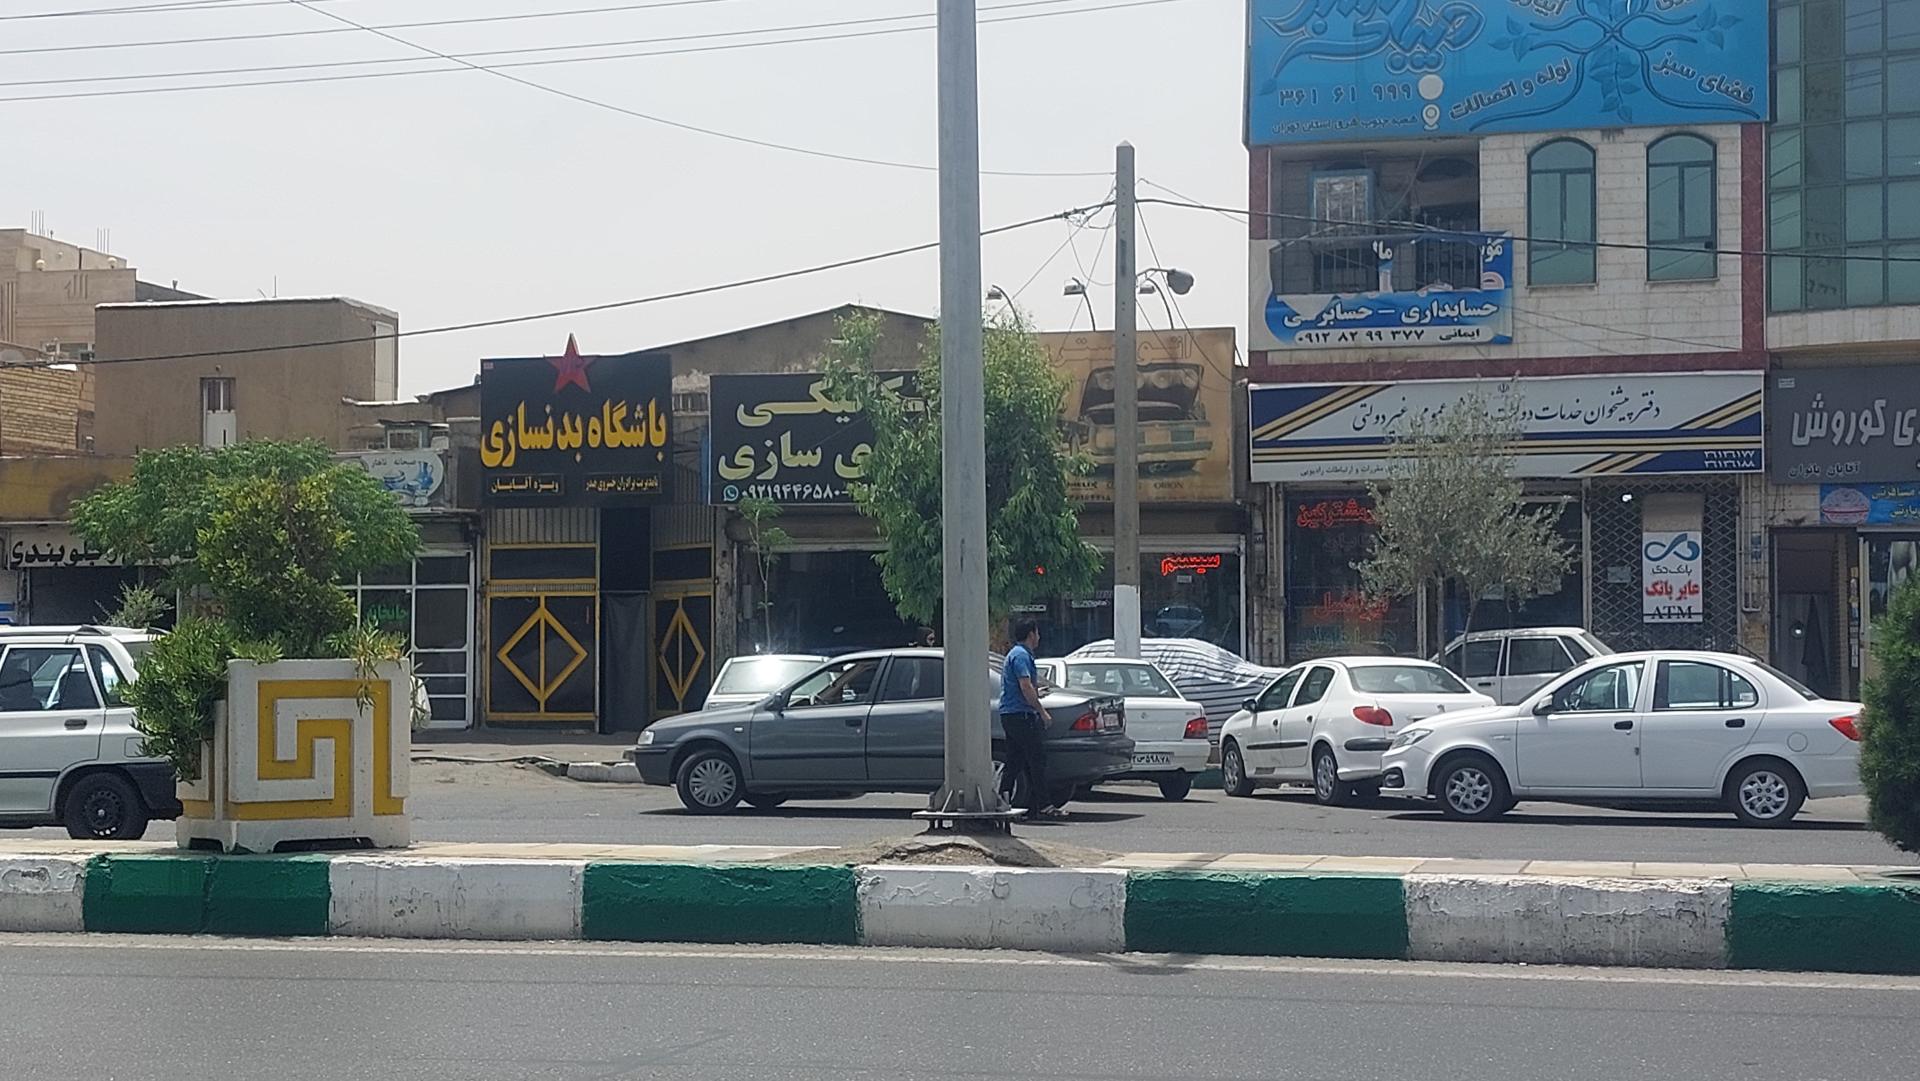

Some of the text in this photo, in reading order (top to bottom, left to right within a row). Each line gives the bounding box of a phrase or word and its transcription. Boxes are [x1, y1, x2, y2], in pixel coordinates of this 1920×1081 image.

[1449, 57, 1572, 120] لوله و اتصالات
[1651, 50, 1755, 104] فضای سبز
[1372, 83, 1412, 101] ۹۹۹
[1284, 301, 1373, 328] حسابری
[1401, 299, 1499, 324] حسابداری
[1297, 327, 1481, 344] ایمانی ۰۹۱۲ ۸۲ ۹۹ ۳۷۷
[1534, 398, 1583, 421] خدمات
[1583, 385, 1633, 425] پیشخوان
[1629, 390, 1661, 424] دفتر
[480, 397, 667, 468] باشگاه بدنسازی
[1791, 393, 1887, 446] کوروش
[718, 430, 822, 480] سازی
[1671, 565, 1693, 576] بانک
[1645, 580, 1700, 600] عابر بانک
[1651, 606, 1693, 620] ATM
